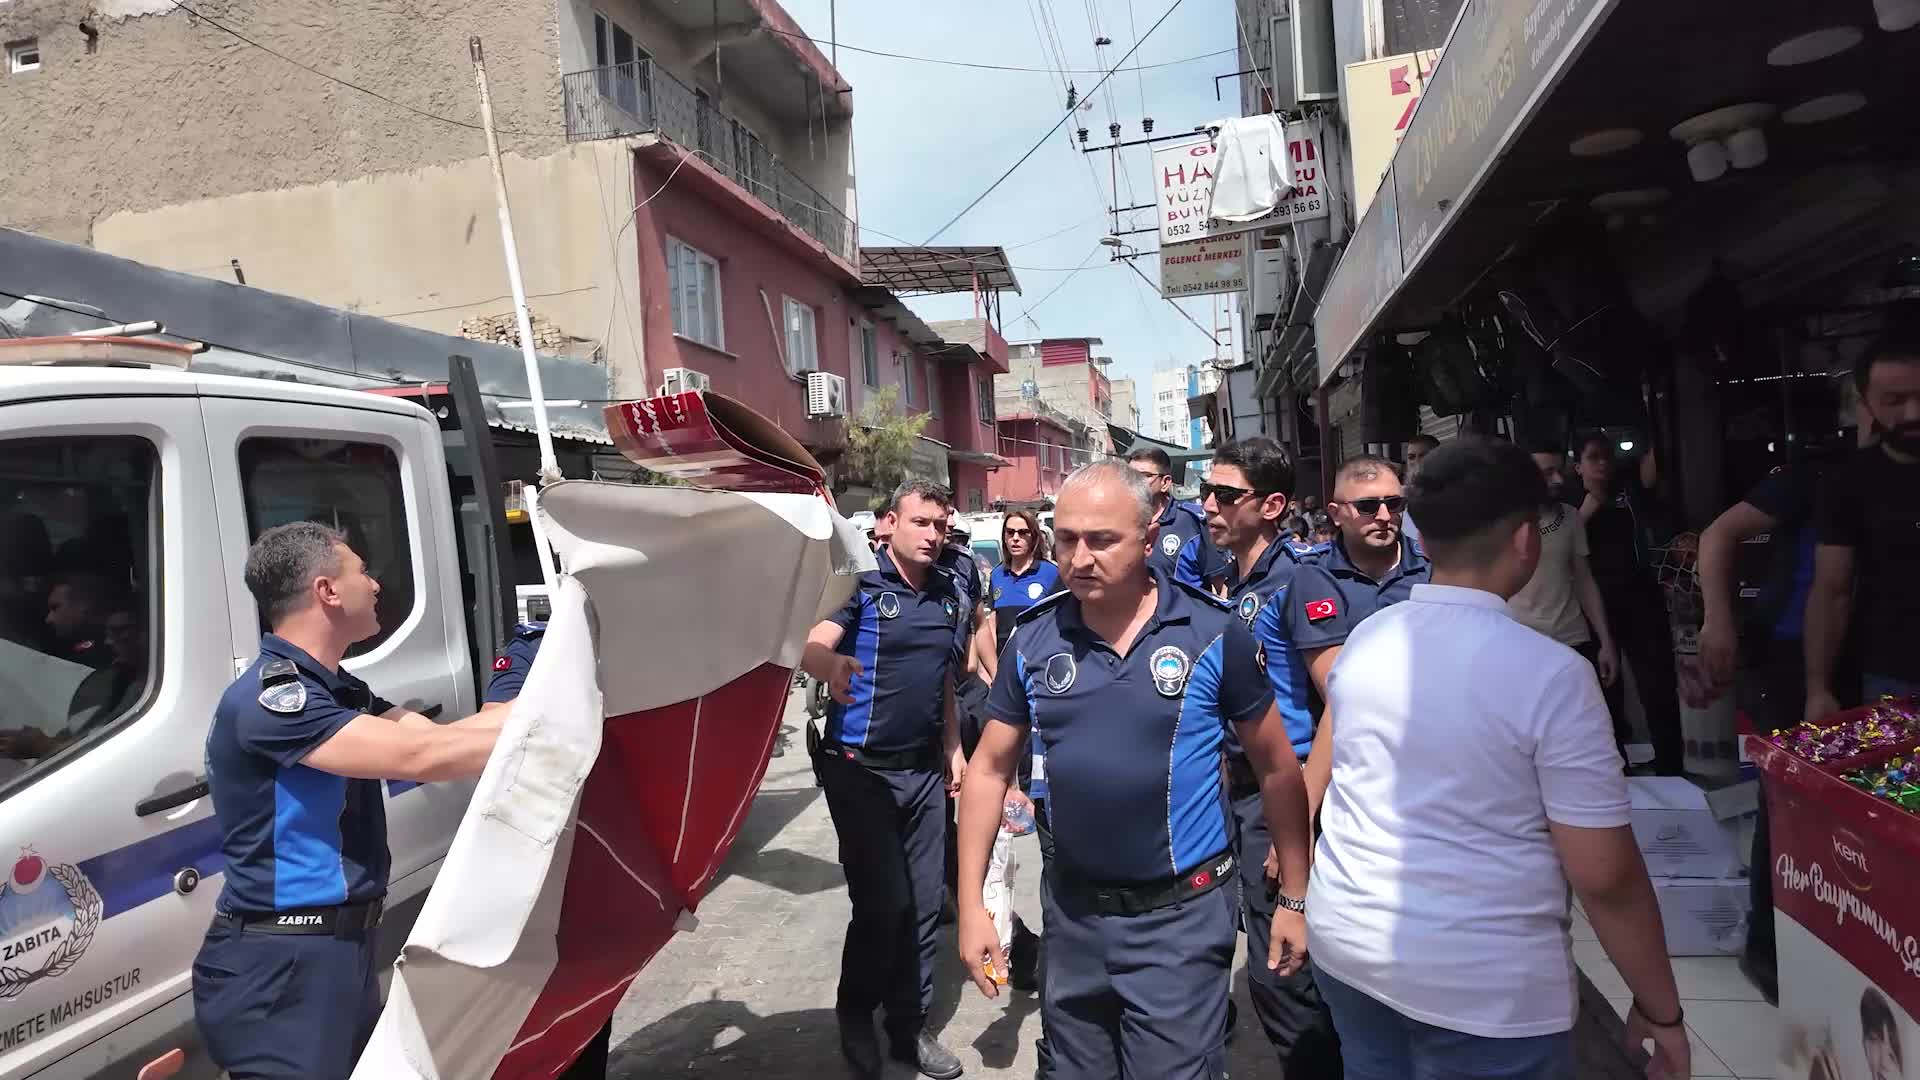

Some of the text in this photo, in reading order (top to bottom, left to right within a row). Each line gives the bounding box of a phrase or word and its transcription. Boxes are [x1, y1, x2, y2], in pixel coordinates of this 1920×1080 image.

[1164, 161, 1213, 188] HA
[1295, 167, 1315, 182] ZU
[1167, 205, 1204, 221] BUH
[1167, 223, 1190, 236] 0532
[1273, 204, 1291, 217] 593
[1294, 202, 1306, 214] 56
[1308, 199, 1321, 211] 63
[1183, 282, 1202, 292] 0542
[1221, 279, 1231, 288] 98
[277, 915, 323, 925] ZABITA
[3, 926, 62, 961] ZABITA
[0, 967, 141, 1053] METE MAHSUSTUR
